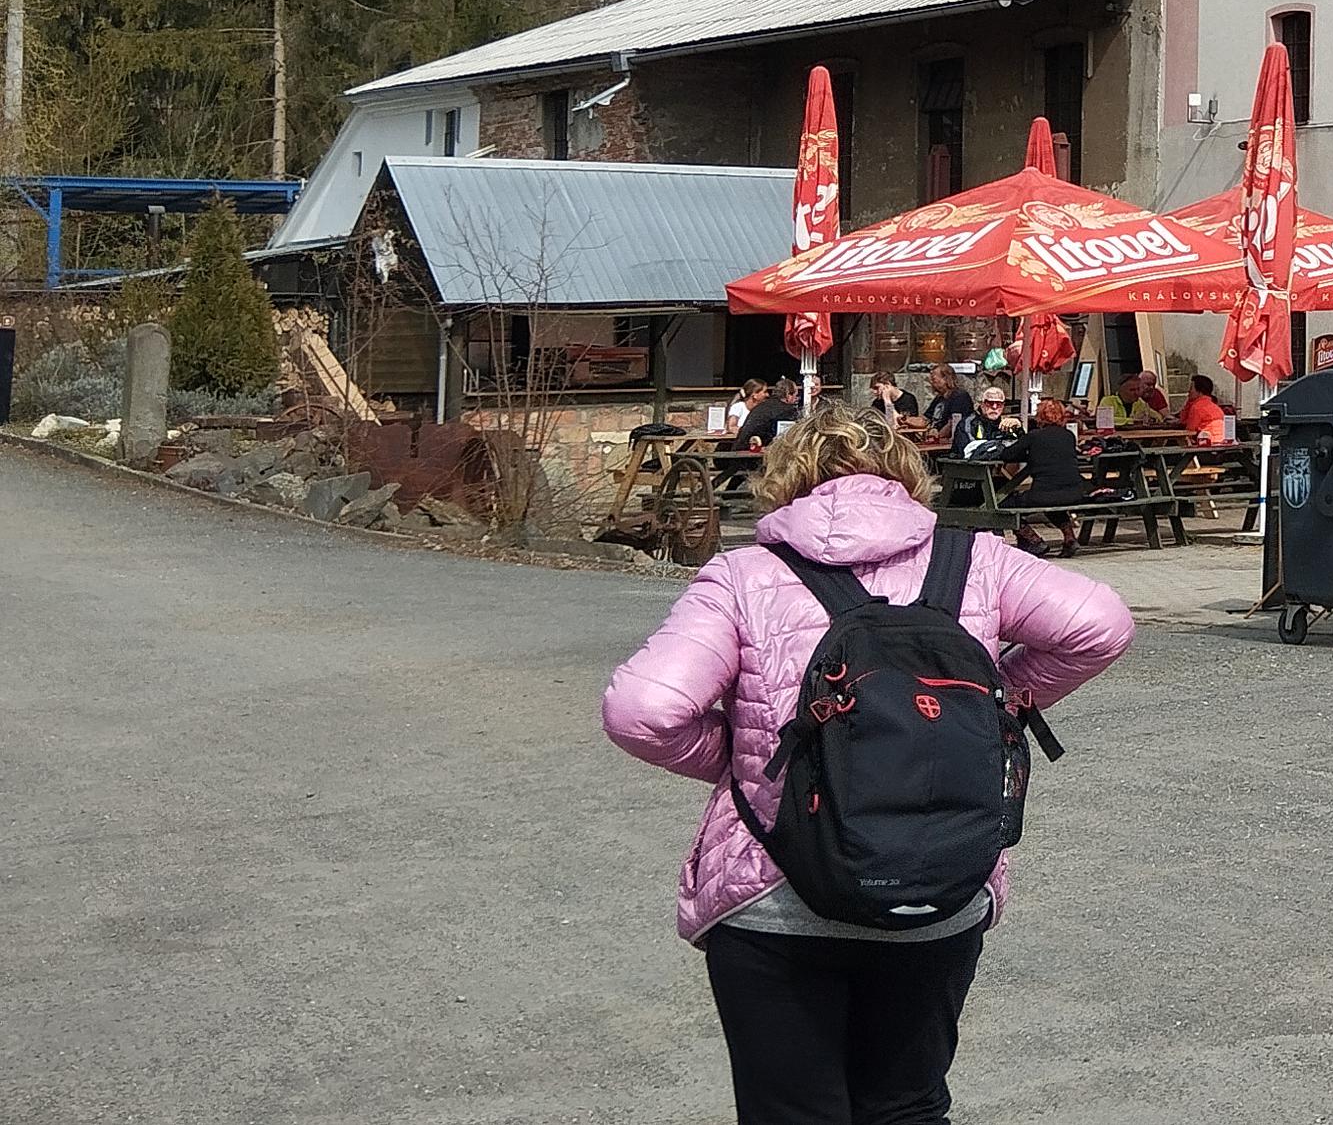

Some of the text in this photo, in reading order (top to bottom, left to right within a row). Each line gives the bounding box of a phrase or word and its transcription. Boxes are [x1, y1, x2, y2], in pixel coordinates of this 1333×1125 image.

[784, 218, 1005, 283] Litovel
[1024, 219, 1191, 281] Litovel
[822, 292, 977, 308] KRÁLOVSKÉ PIVO
